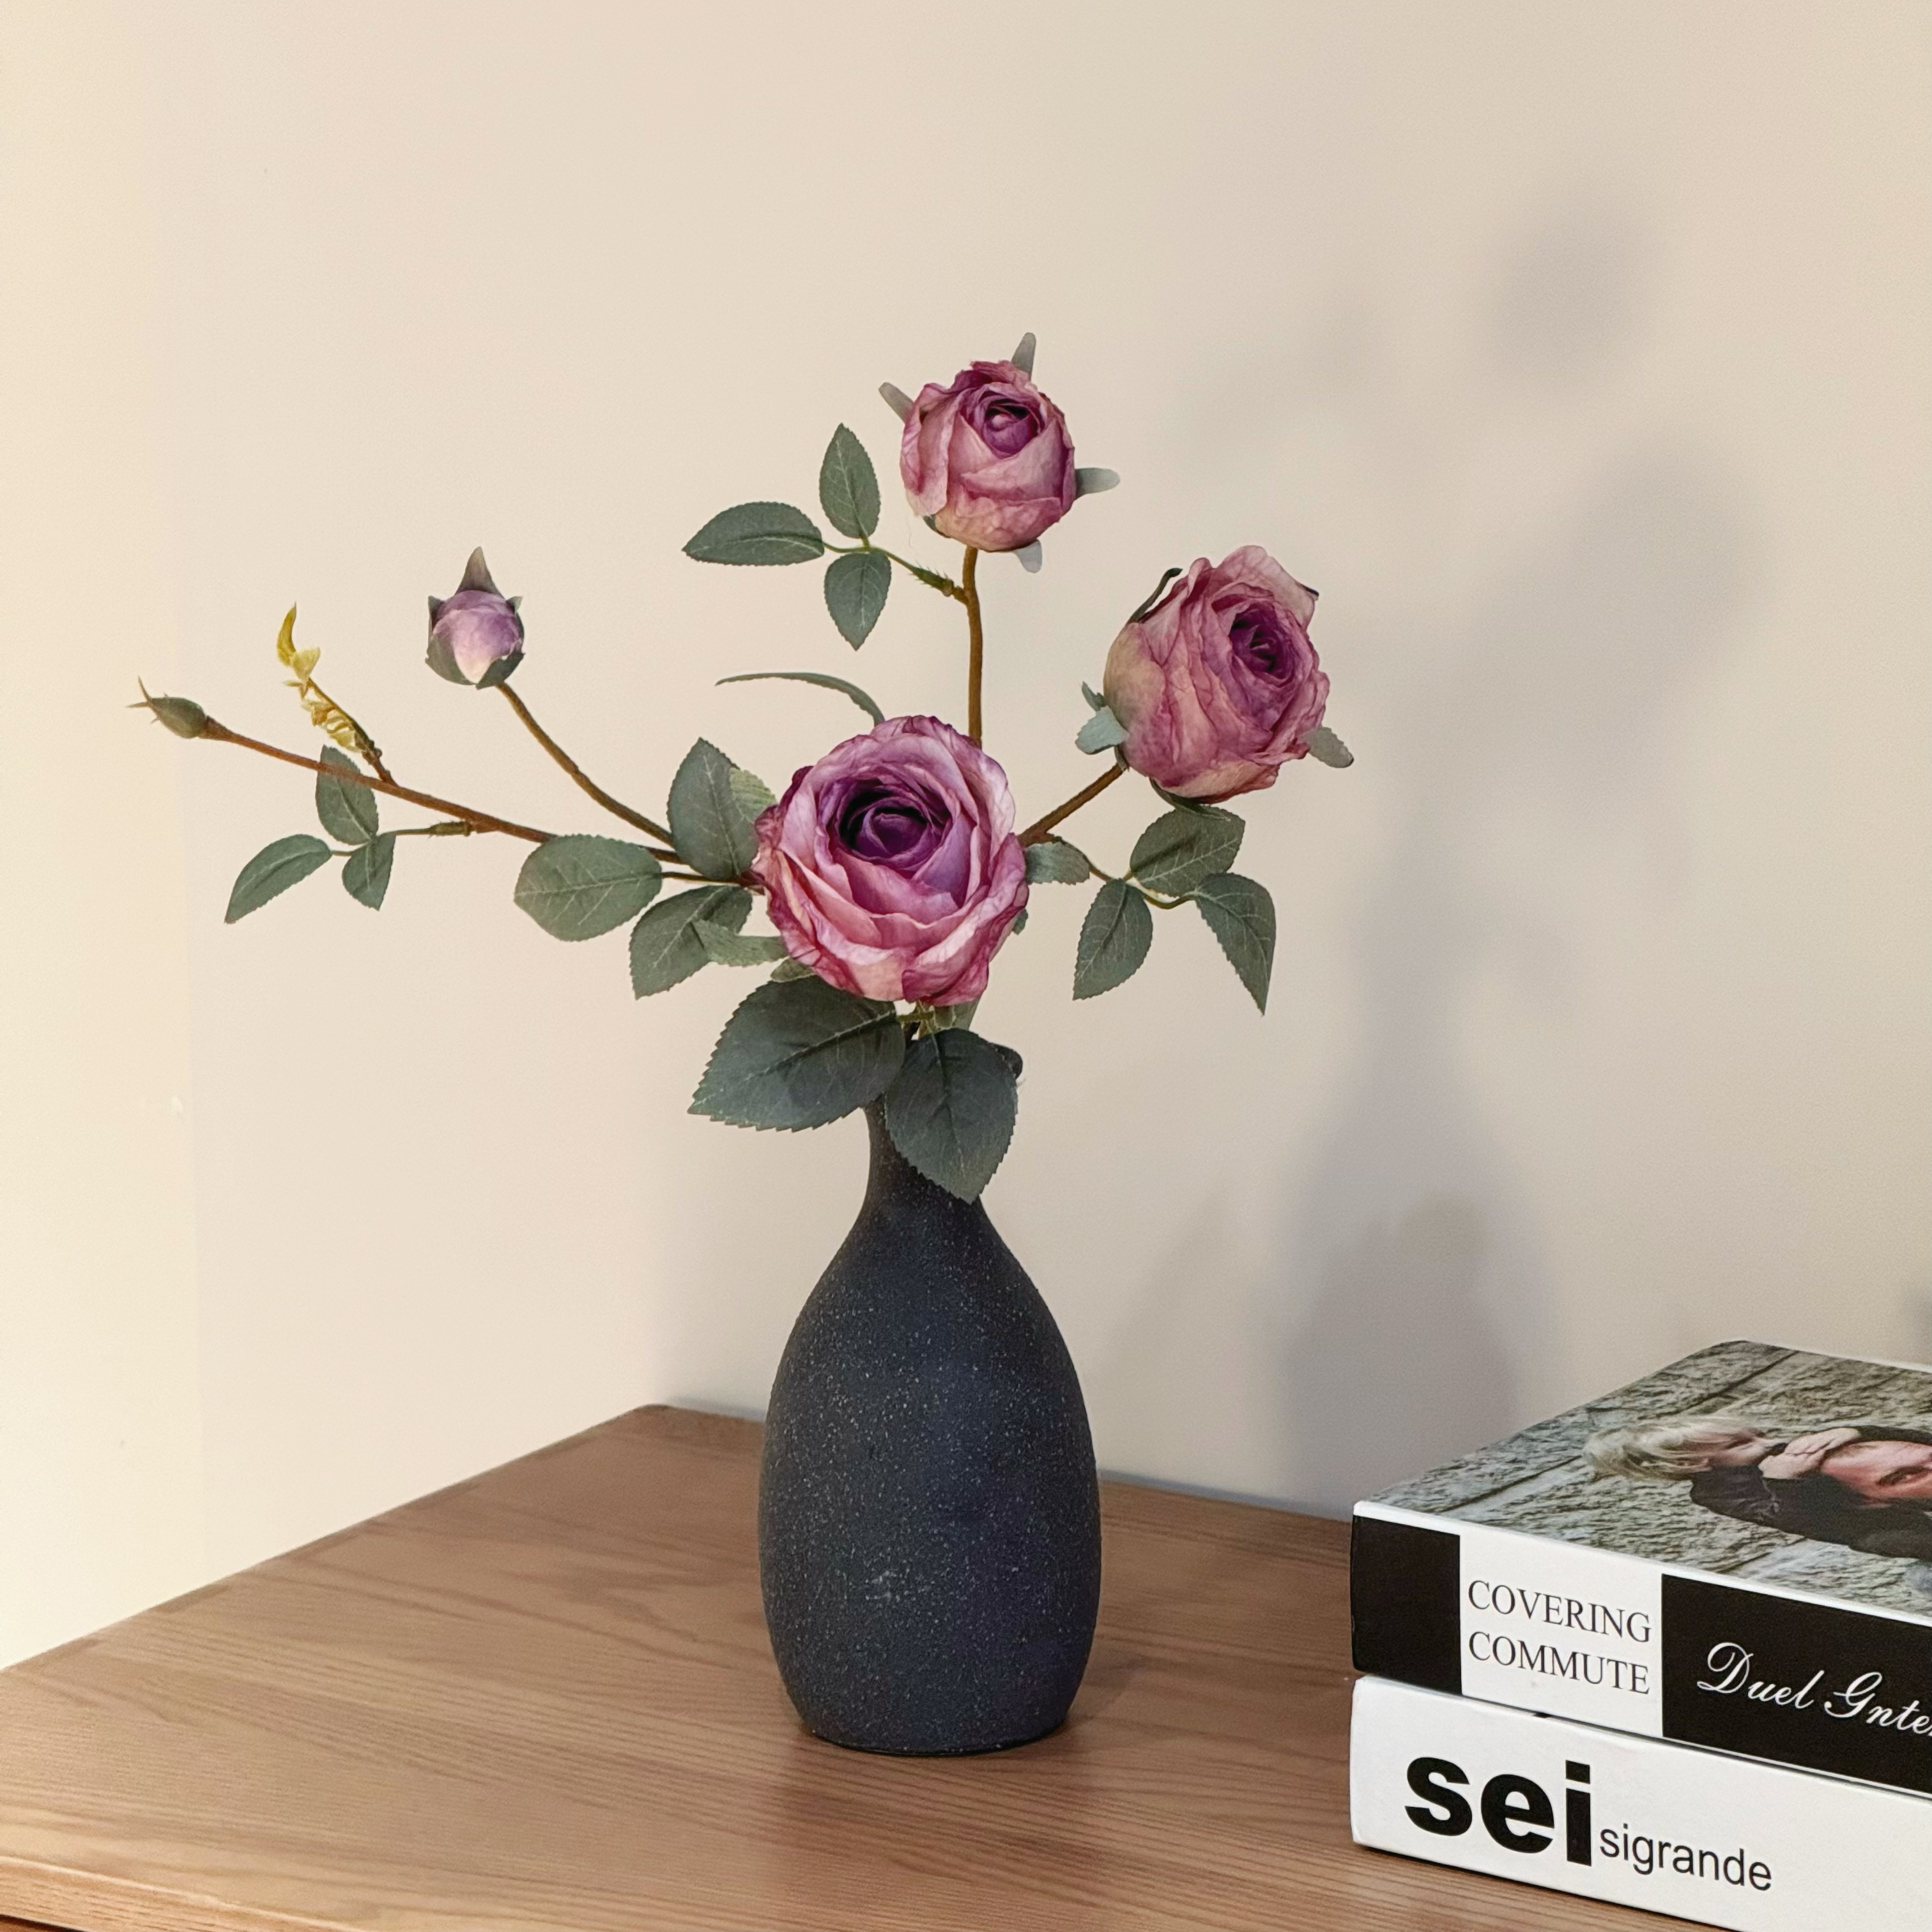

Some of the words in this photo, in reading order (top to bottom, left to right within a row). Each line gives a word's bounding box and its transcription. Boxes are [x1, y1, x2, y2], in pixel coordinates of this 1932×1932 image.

[1468, 1579, 1652, 1643] COVERING
[1468, 1630, 1651, 1695] COMMUTE
[1696, 1641, 1825, 1710] Duel
[1404, 1756, 1593, 1867] sei
[1599, 1822, 1773, 1892] sigrande
